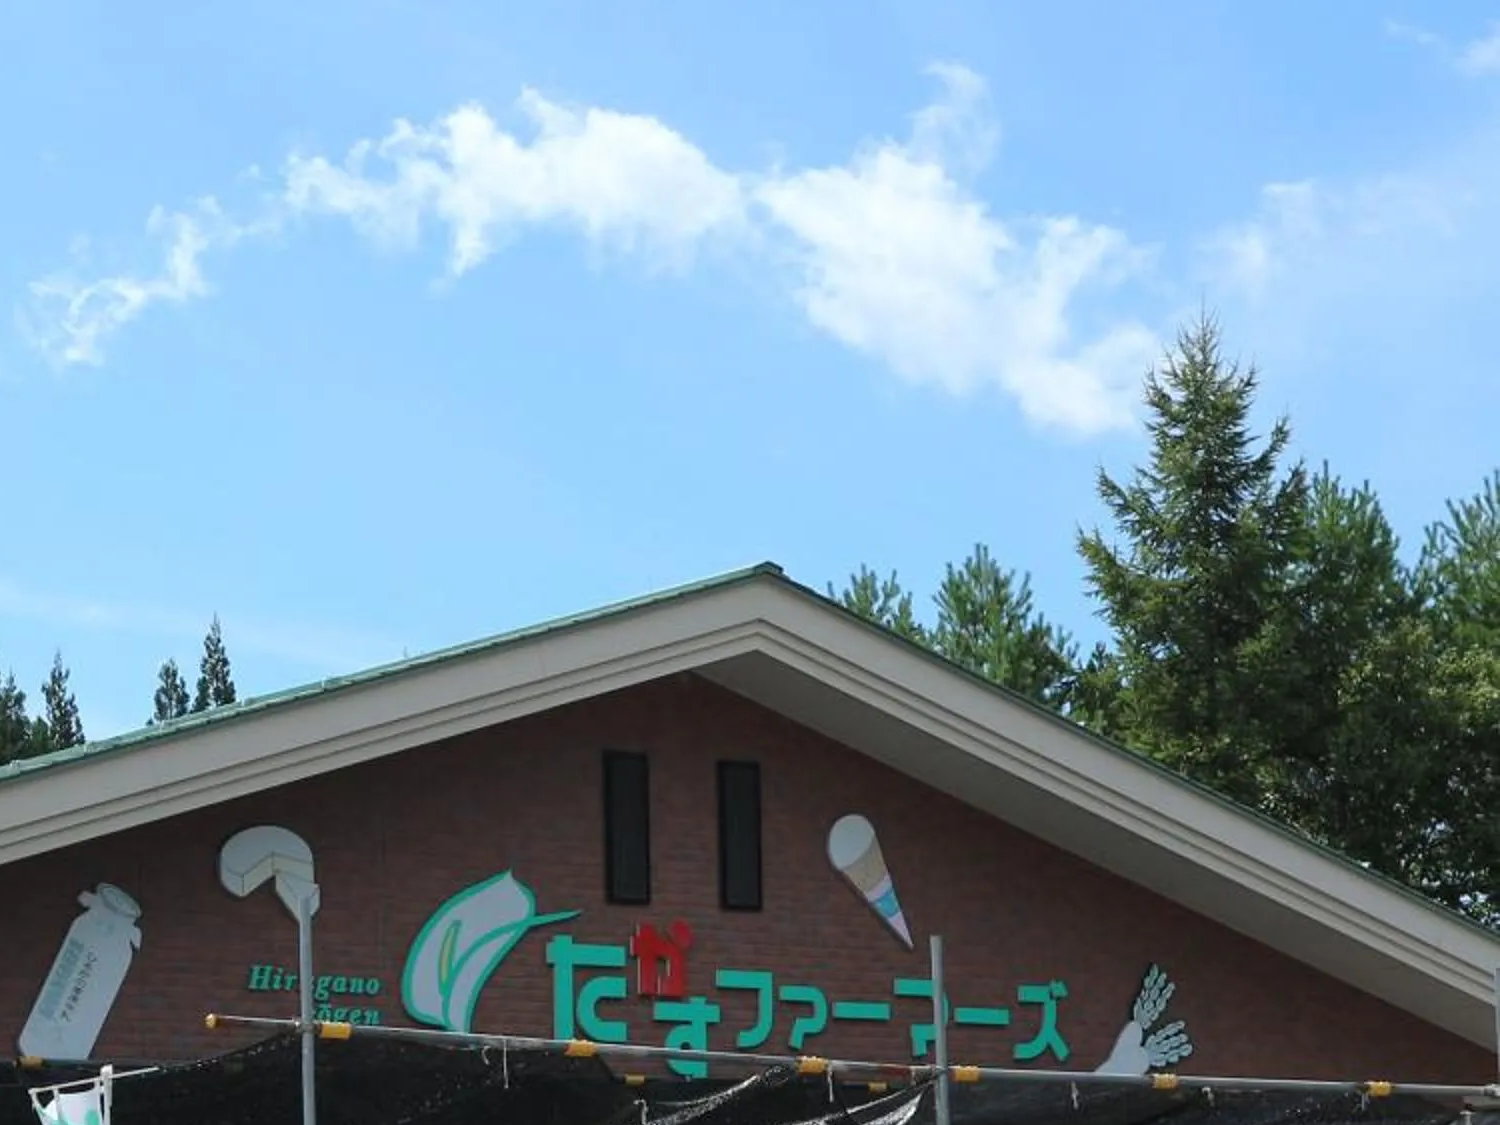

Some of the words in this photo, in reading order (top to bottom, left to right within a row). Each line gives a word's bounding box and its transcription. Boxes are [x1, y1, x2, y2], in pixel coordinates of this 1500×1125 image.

[249, 965, 381, 1000] Hirgano
[546, 920, 1069, 1079] たかすファーマーズ
